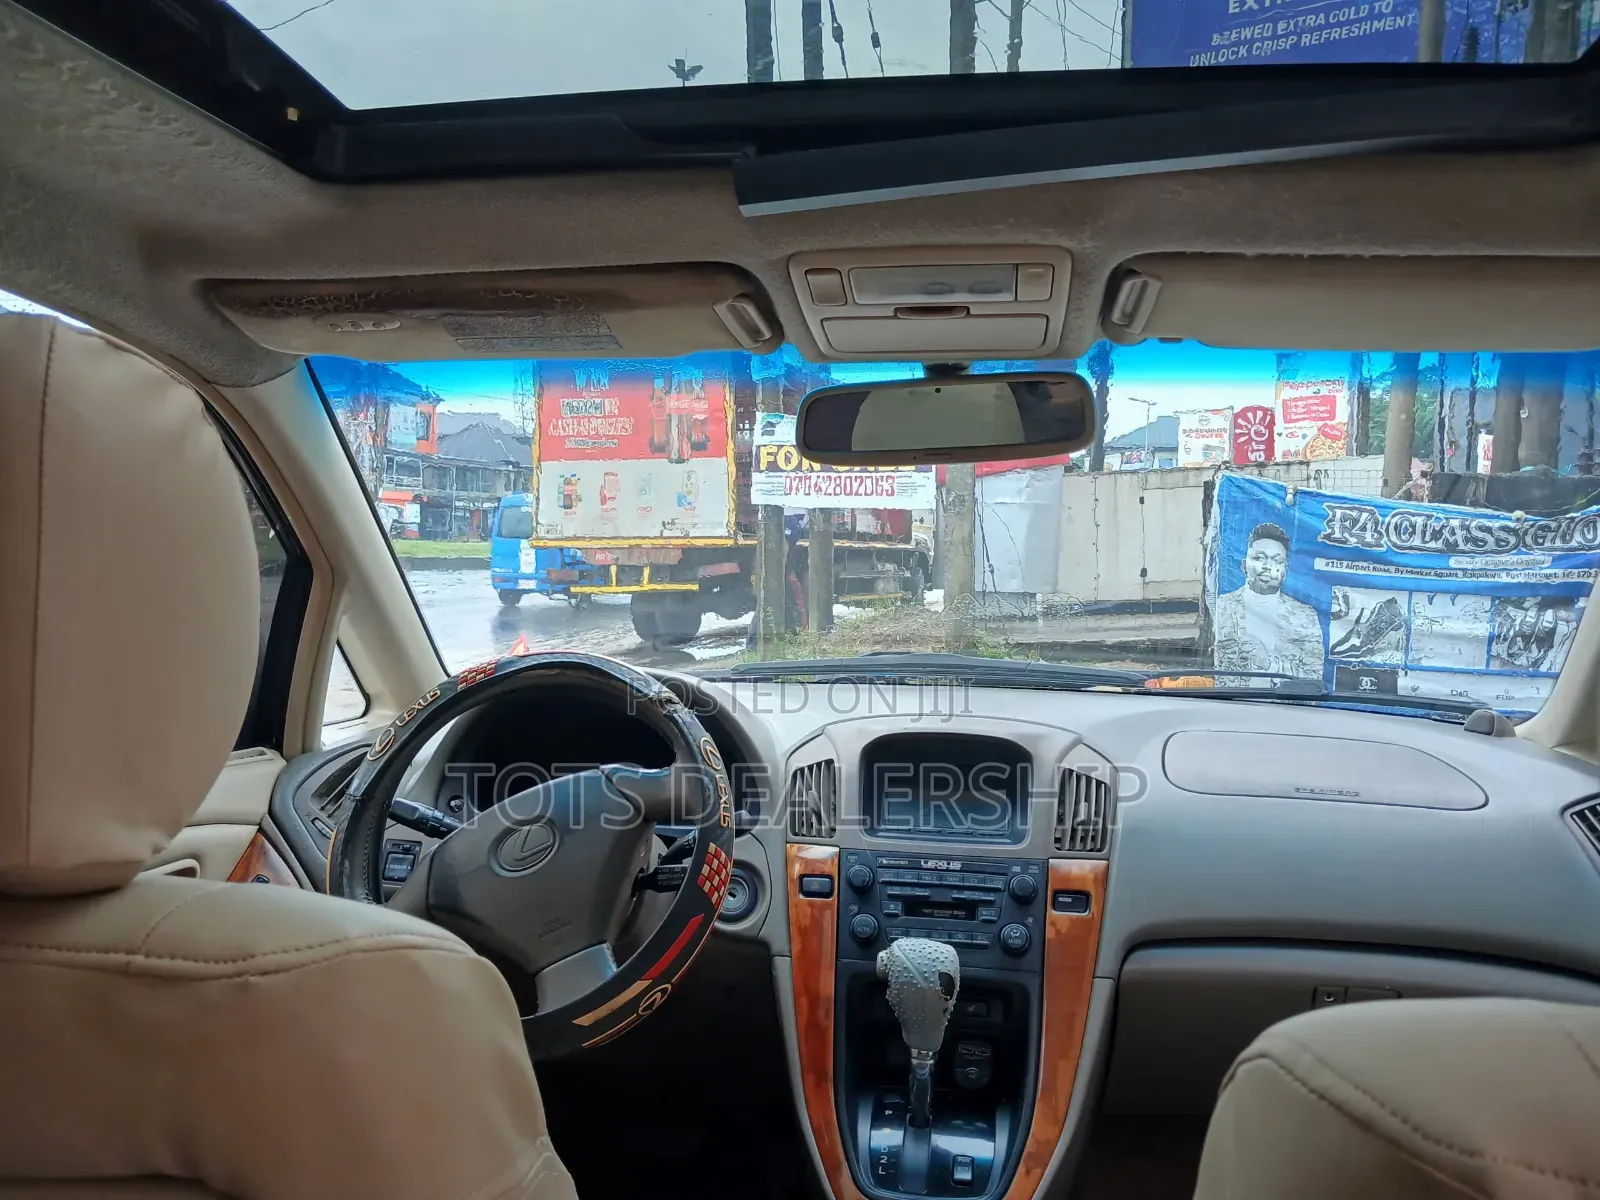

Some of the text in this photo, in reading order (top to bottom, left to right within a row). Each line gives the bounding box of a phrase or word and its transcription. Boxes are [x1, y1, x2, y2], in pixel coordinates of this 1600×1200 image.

[1277, 14, 1325, 34] EXTRA
[1329, 4, 1369, 23] COLD
[1373, 0, 1393, 14] TO
[1190, 13, 1415, 67] UNLOCK CRISP REFRESHMENT
[784, 474, 896, 497] 07042802063
[1387, 512, 1518, 551] CLASS
[1324, 561, 1344, 569] #115
[1345, 562, 1371, 572] Airport
[1394, 567, 1404, 575] By
[395, 687, 441, 727] LEXUS
[921, 860, 961, 868] LEXUS
[881, 1145, 889, 1153] D
[880, 1155, 888, 1164] 2
[878, 1166, 887, 1175] L
